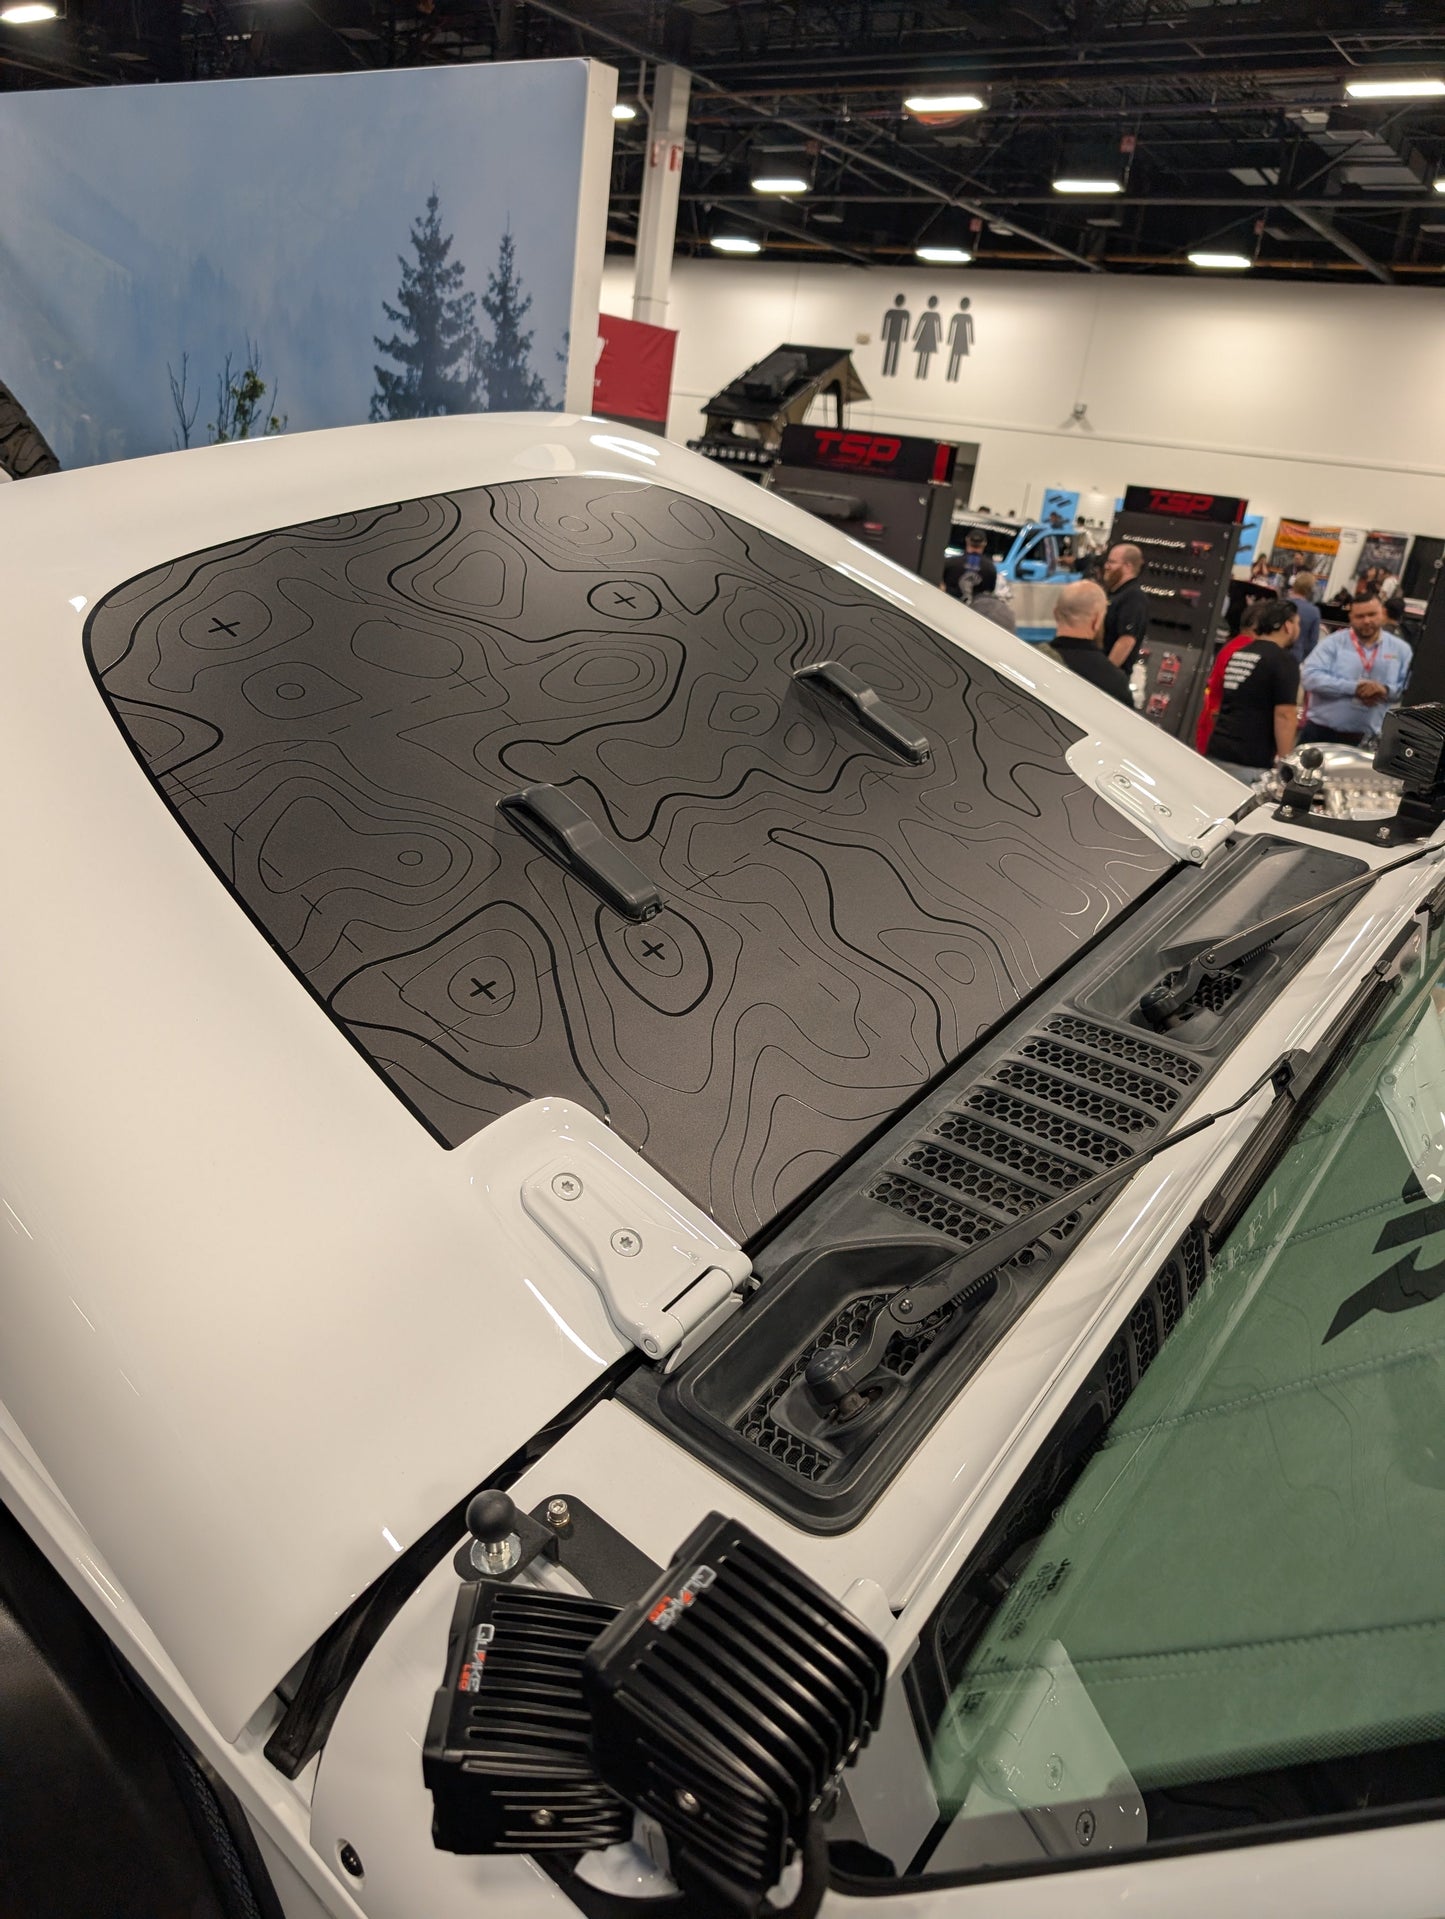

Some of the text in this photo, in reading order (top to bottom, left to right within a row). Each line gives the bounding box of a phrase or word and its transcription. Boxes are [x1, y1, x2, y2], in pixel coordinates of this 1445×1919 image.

[815, 430, 902, 466] TSP
[1150, 489, 1214, 514] TSP
[1047, 1558, 1072, 1591] Jeep
[652, 1564, 718, 1632] QUAKE
[467, 1623, 496, 1693] QUAKE
